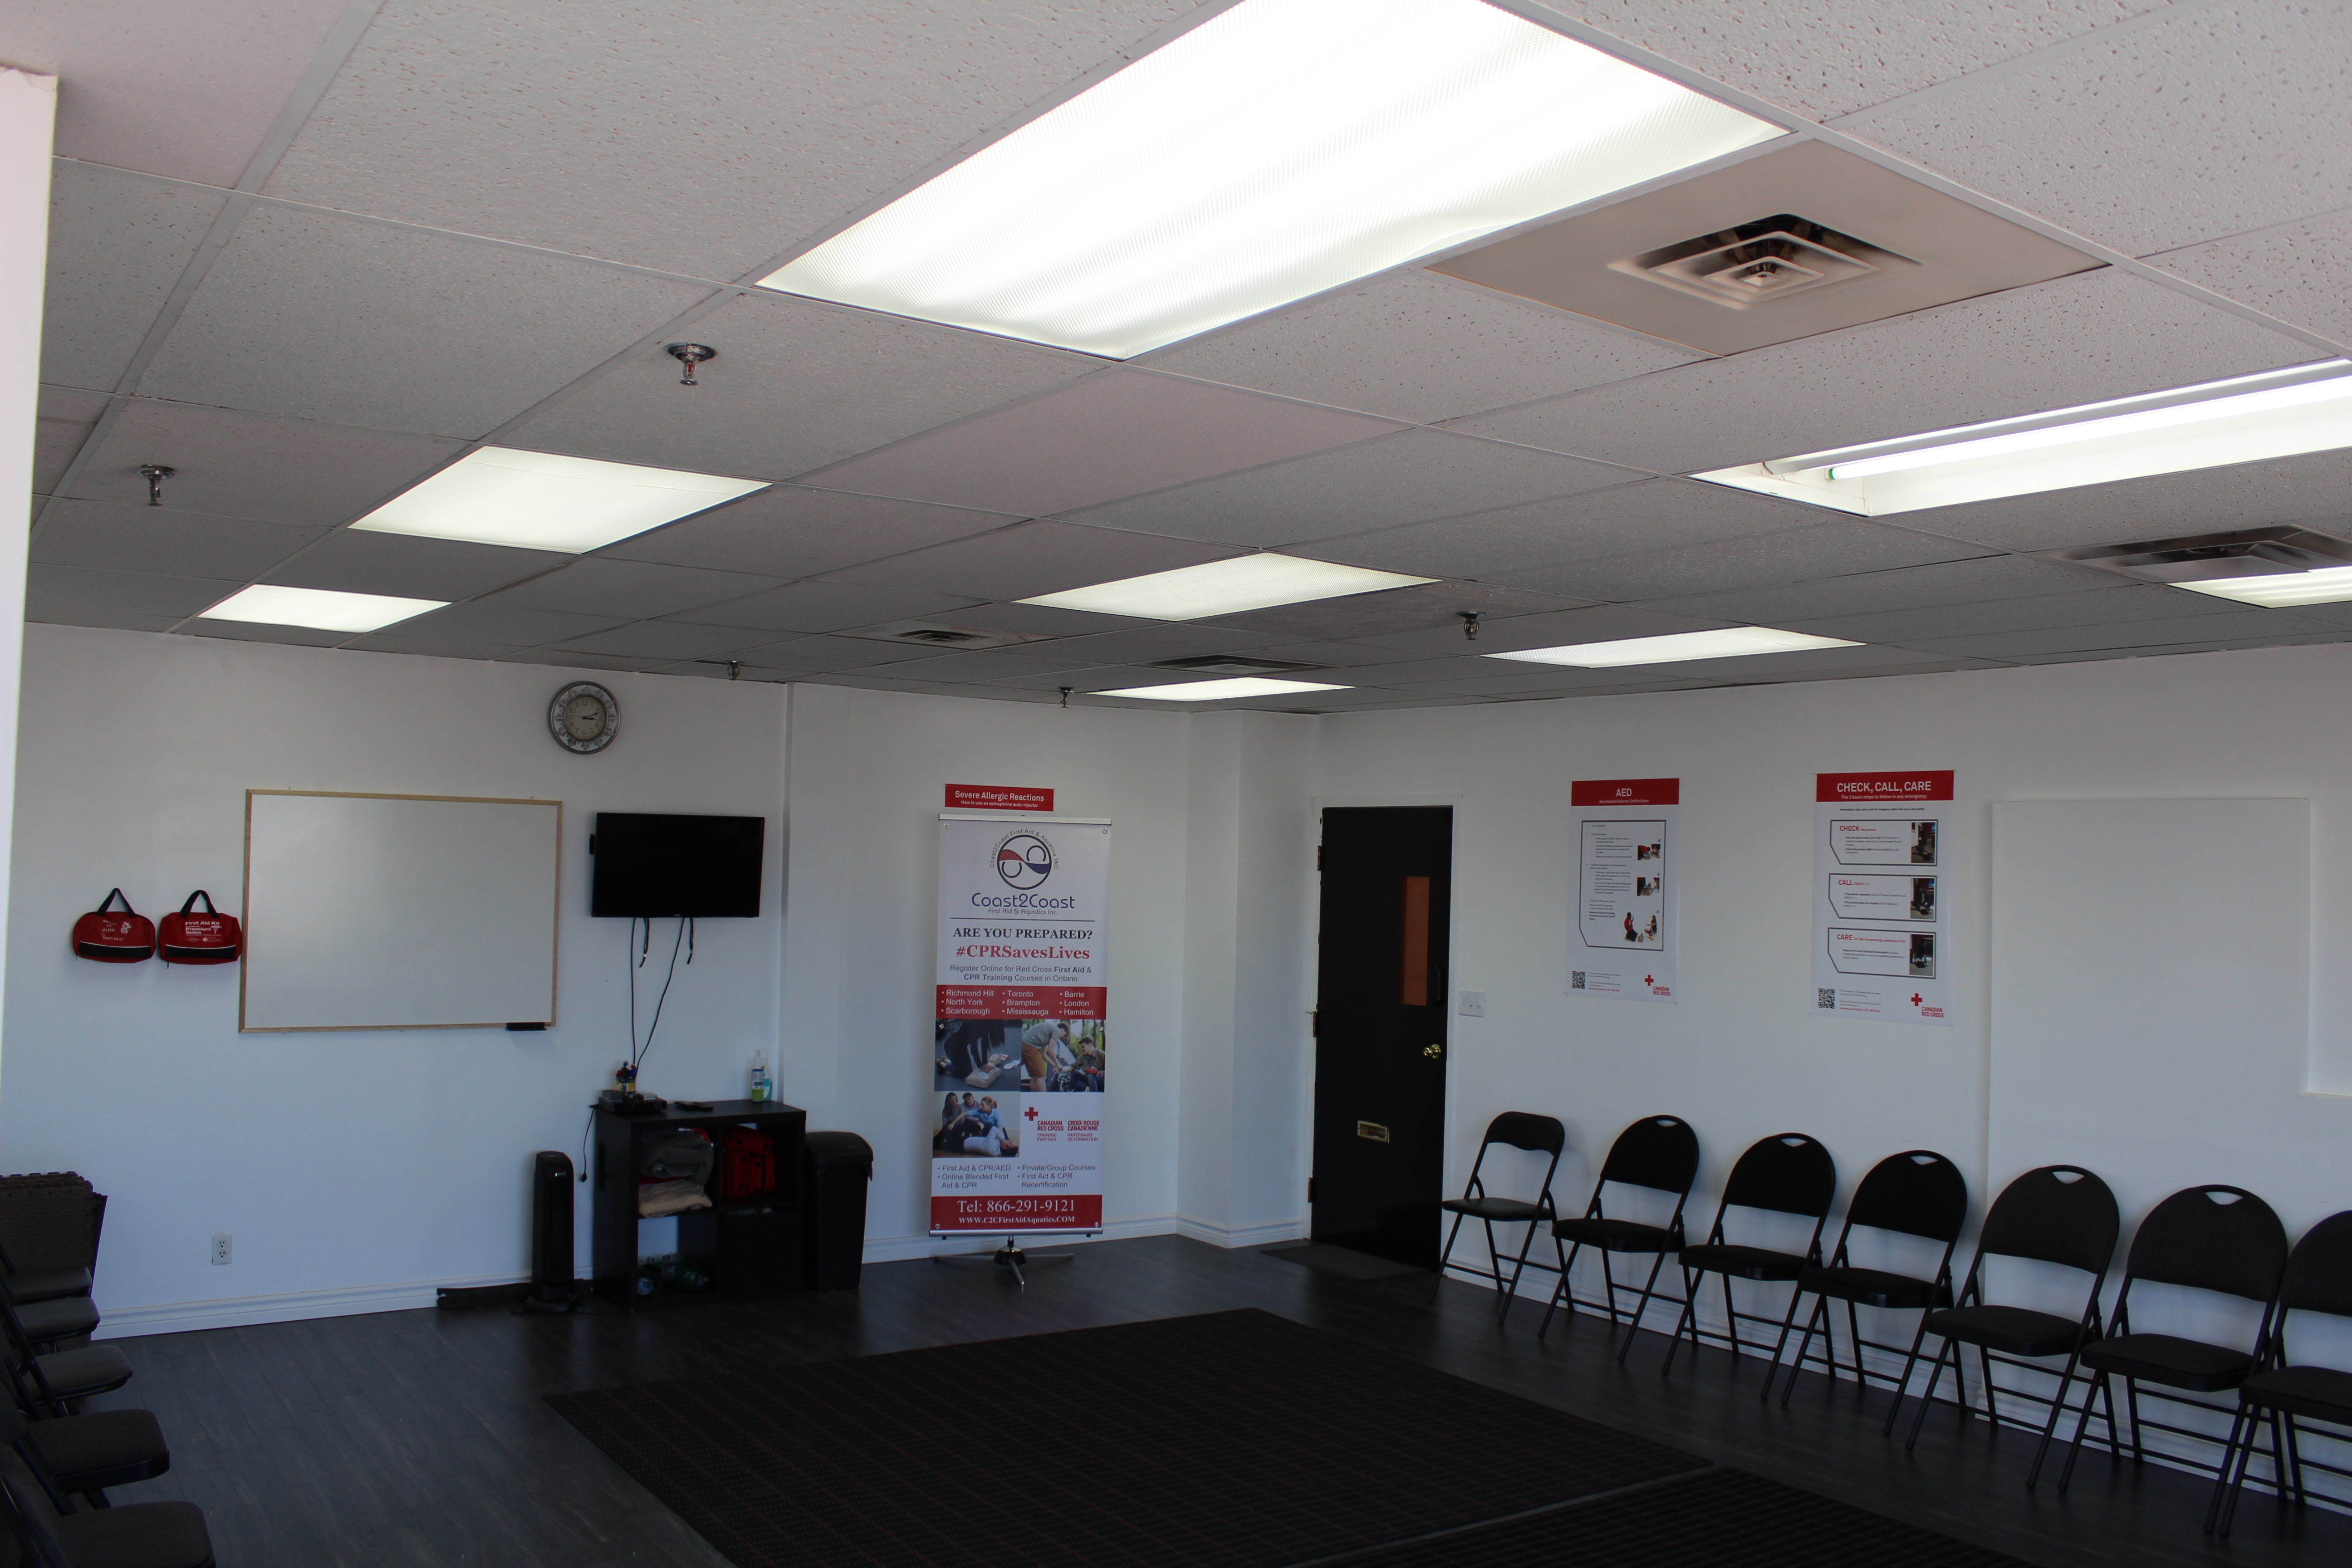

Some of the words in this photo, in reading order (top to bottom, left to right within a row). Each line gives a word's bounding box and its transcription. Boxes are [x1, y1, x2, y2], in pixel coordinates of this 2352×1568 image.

[1837, 783, 1873, 793] CHECK,
[1875, 782, 1902, 793] CALL,
[1904, 781, 1931, 791] CARE
[981, 792, 1008, 801] Allergic
[1010, 793, 1044, 801] Reactions
[990, 834, 1009, 868] Coast2Coast
[1040, 835, 1056, 857] Aquatics
[972, 893, 1074, 908] Coast2Coast
[953, 928, 980, 937] ARE
[983, 929, 1012, 938] YOU
[1016, 929, 1092, 939] PREPARED?
[956, 945, 1089, 959] #CPRSavesLives
[1007, 999, 1039, 1007] Brampton
[946, 1007, 990, 1015] Scarborough
[1007, 1008, 1049, 1016] Mississauga
[957, 1200, 982, 1212] Tel:
[987, 1200, 1074, 1212] 866-291-9121
